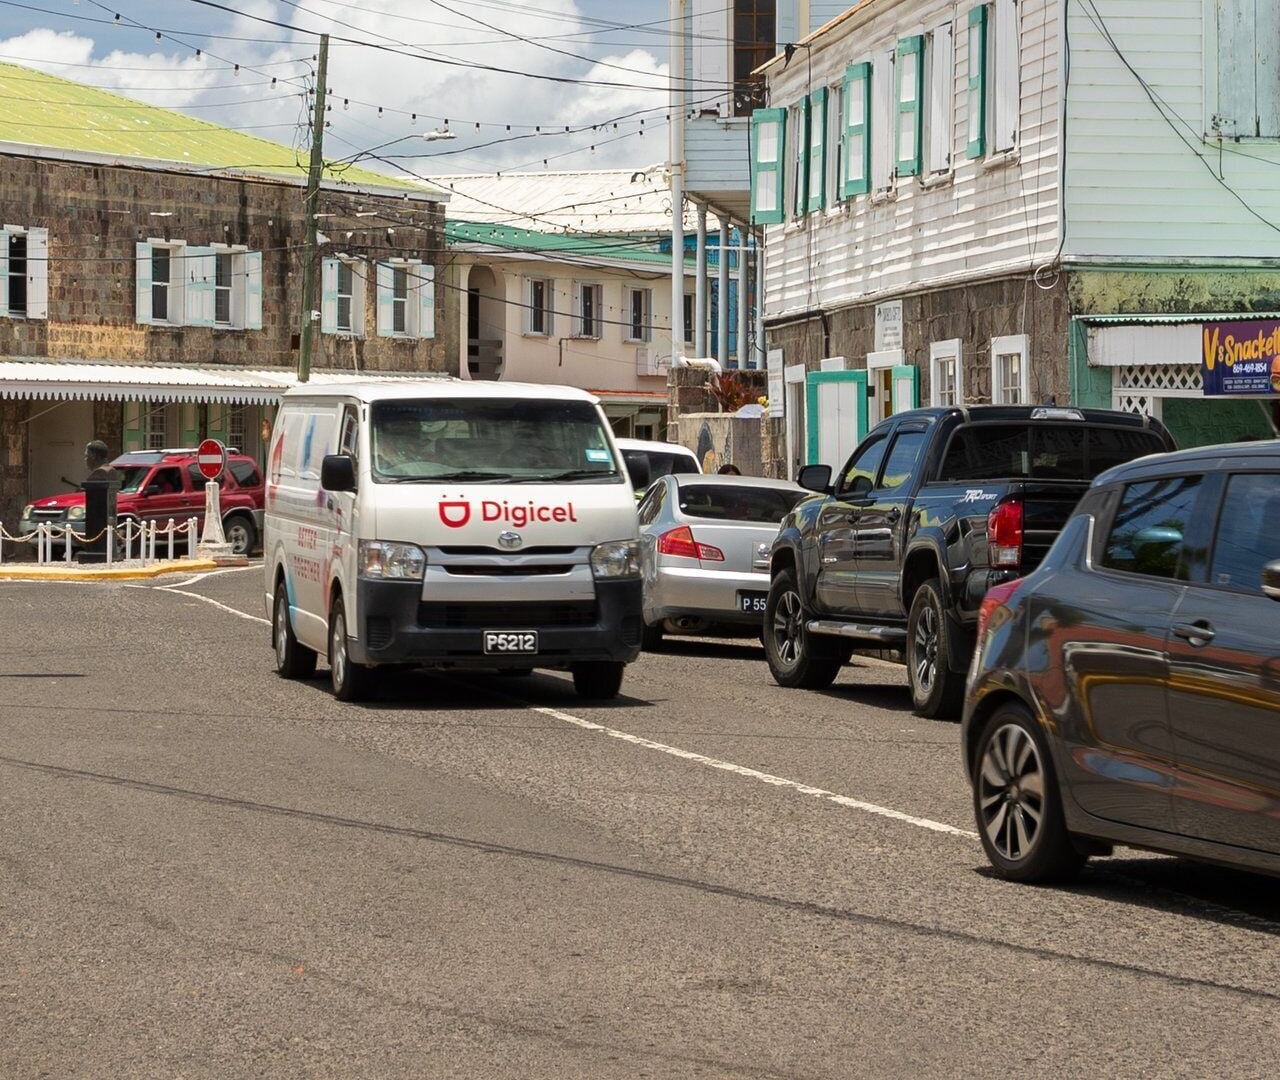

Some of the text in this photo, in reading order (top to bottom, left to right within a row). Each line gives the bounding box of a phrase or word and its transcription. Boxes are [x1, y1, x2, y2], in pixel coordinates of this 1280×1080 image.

[481, 500, 578, 528] Digicel
[743, 598, 751, 611] P
[486, 633, 537, 651] P5212
